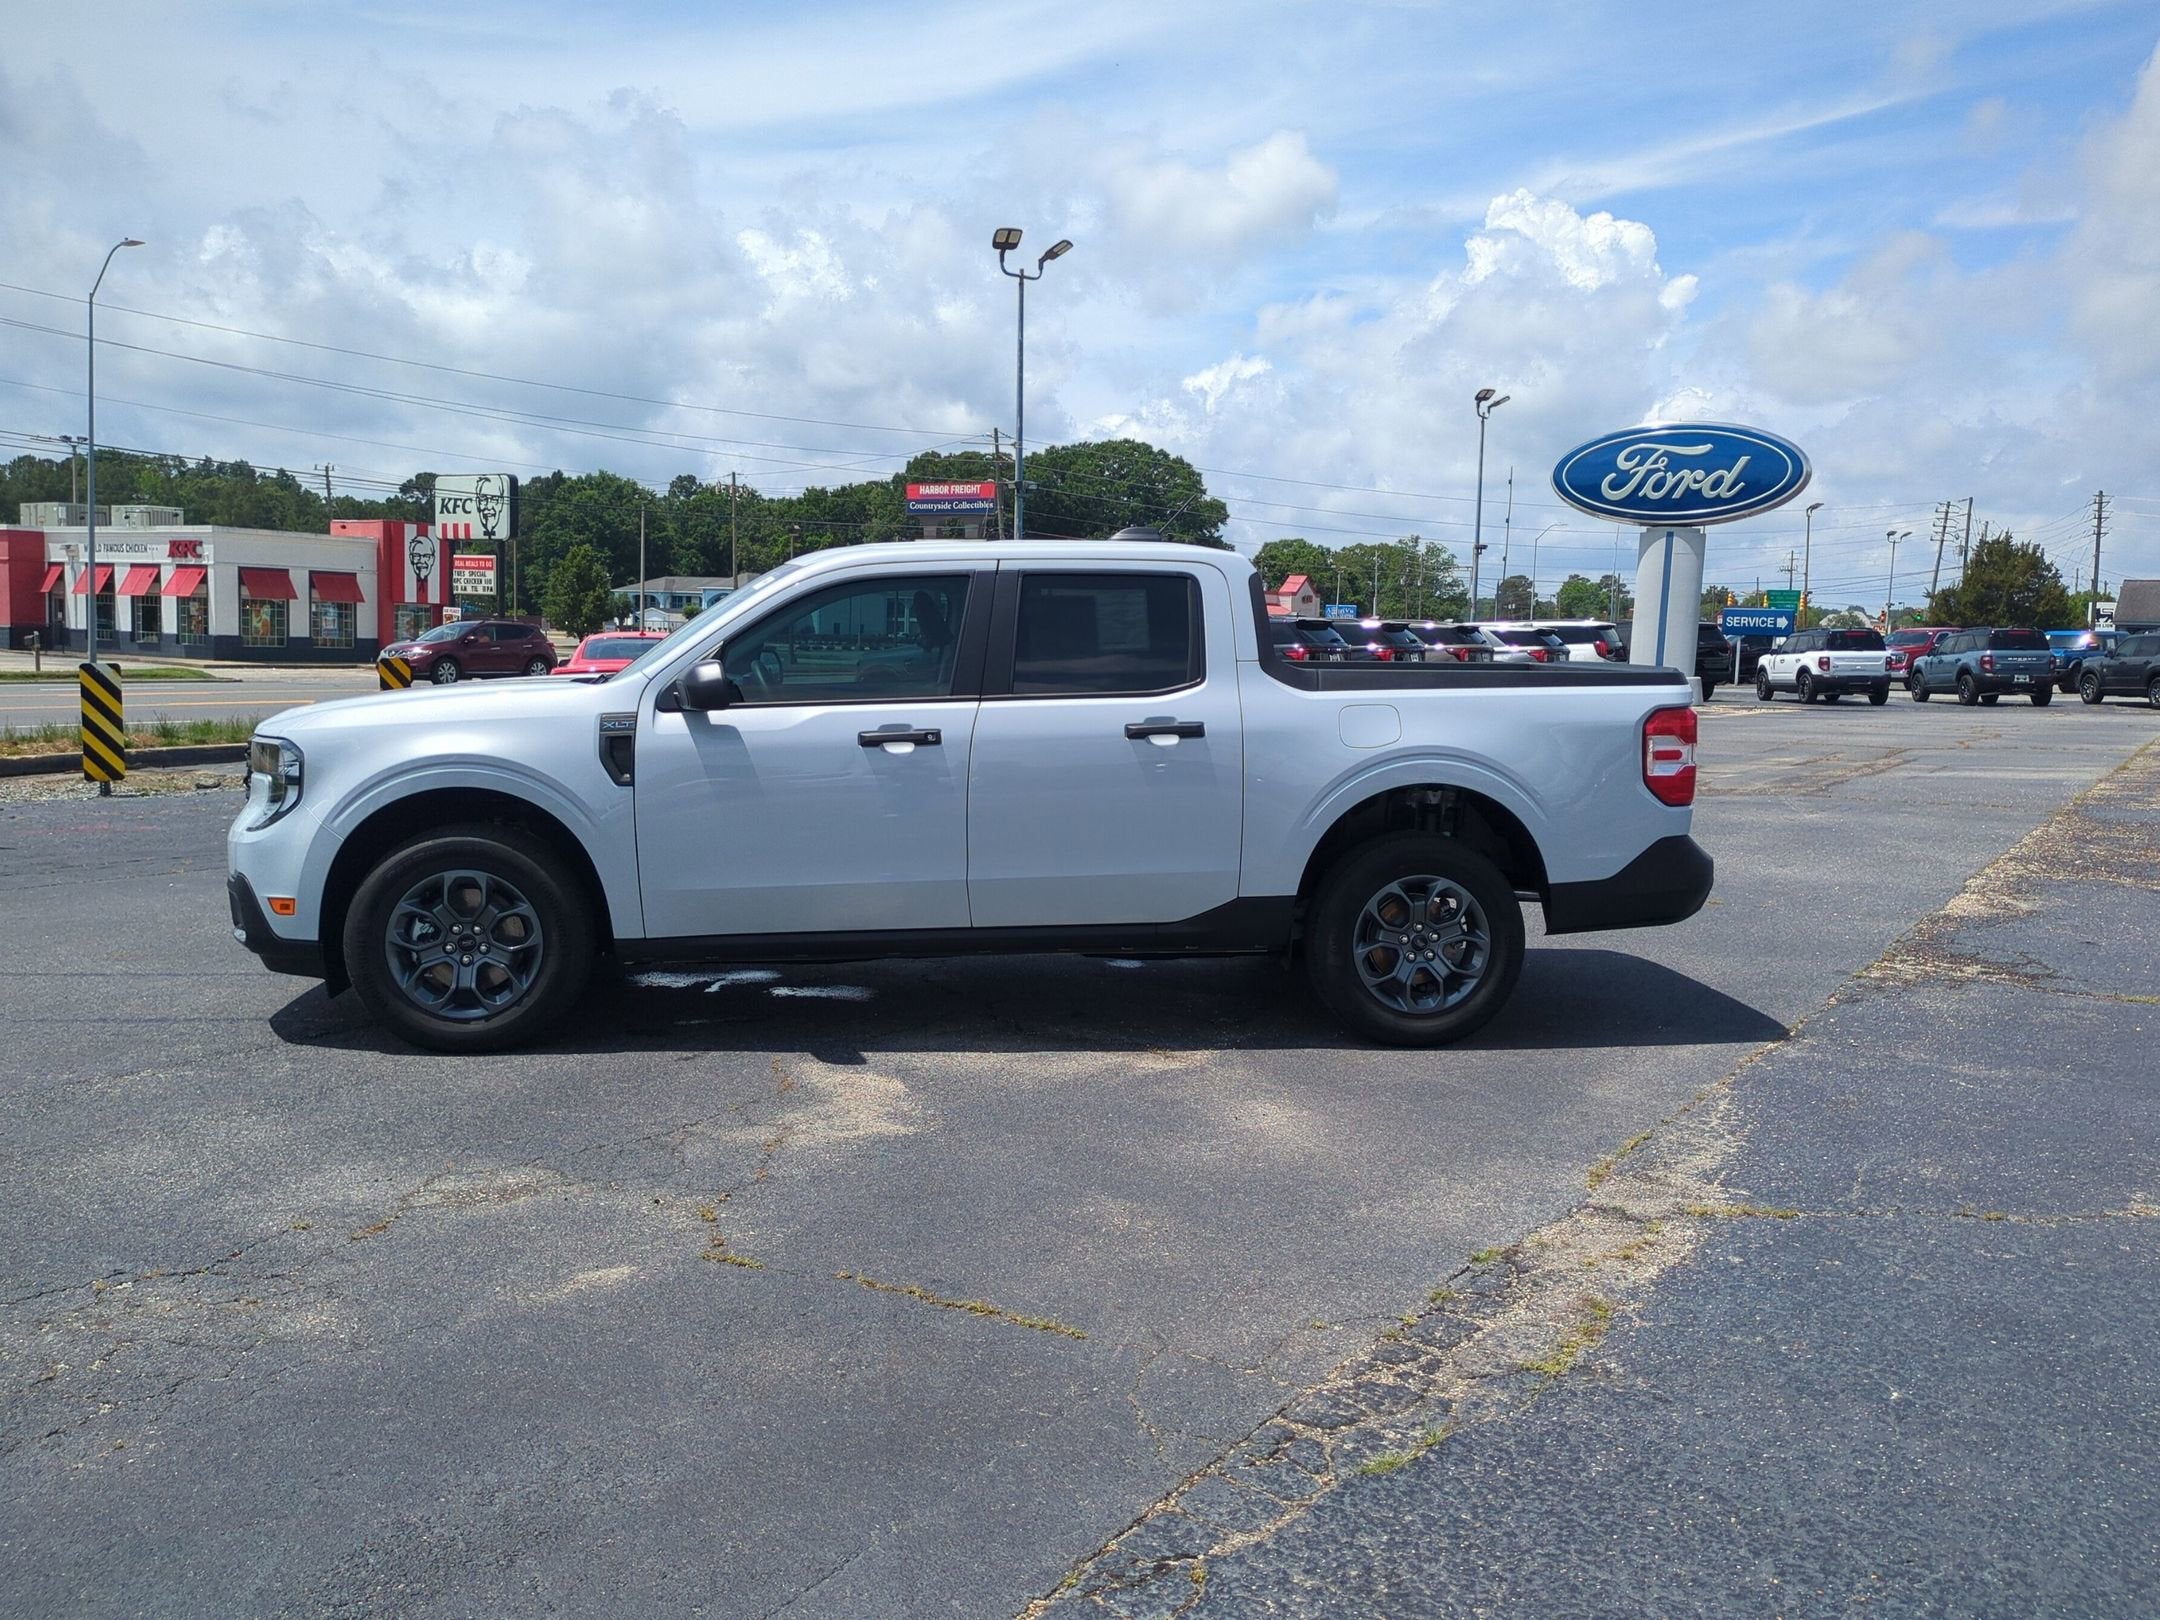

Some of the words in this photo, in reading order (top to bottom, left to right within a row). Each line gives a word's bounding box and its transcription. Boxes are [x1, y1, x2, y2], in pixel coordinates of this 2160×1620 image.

[1601, 442, 1751, 501] Ford
[919, 485, 949, 495] HARBOR
[950, 484, 981, 494] FREIGHT
[439, 497, 473, 515] KFC
[909, 501, 952, 512] Countryside
[952, 500, 994, 510] Collectibles
[83, 543, 102, 553] WLD
[103, 543, 125, 553] FAMOUS
[125, 543, 148, 553] CHICKEN
[167, 540, 203, 558] KFC
[468, 570, 487, 578] SPECIAL
[1725, 616, 1775, 628] SERVICE
[602, 720, 633, 729] XLT
